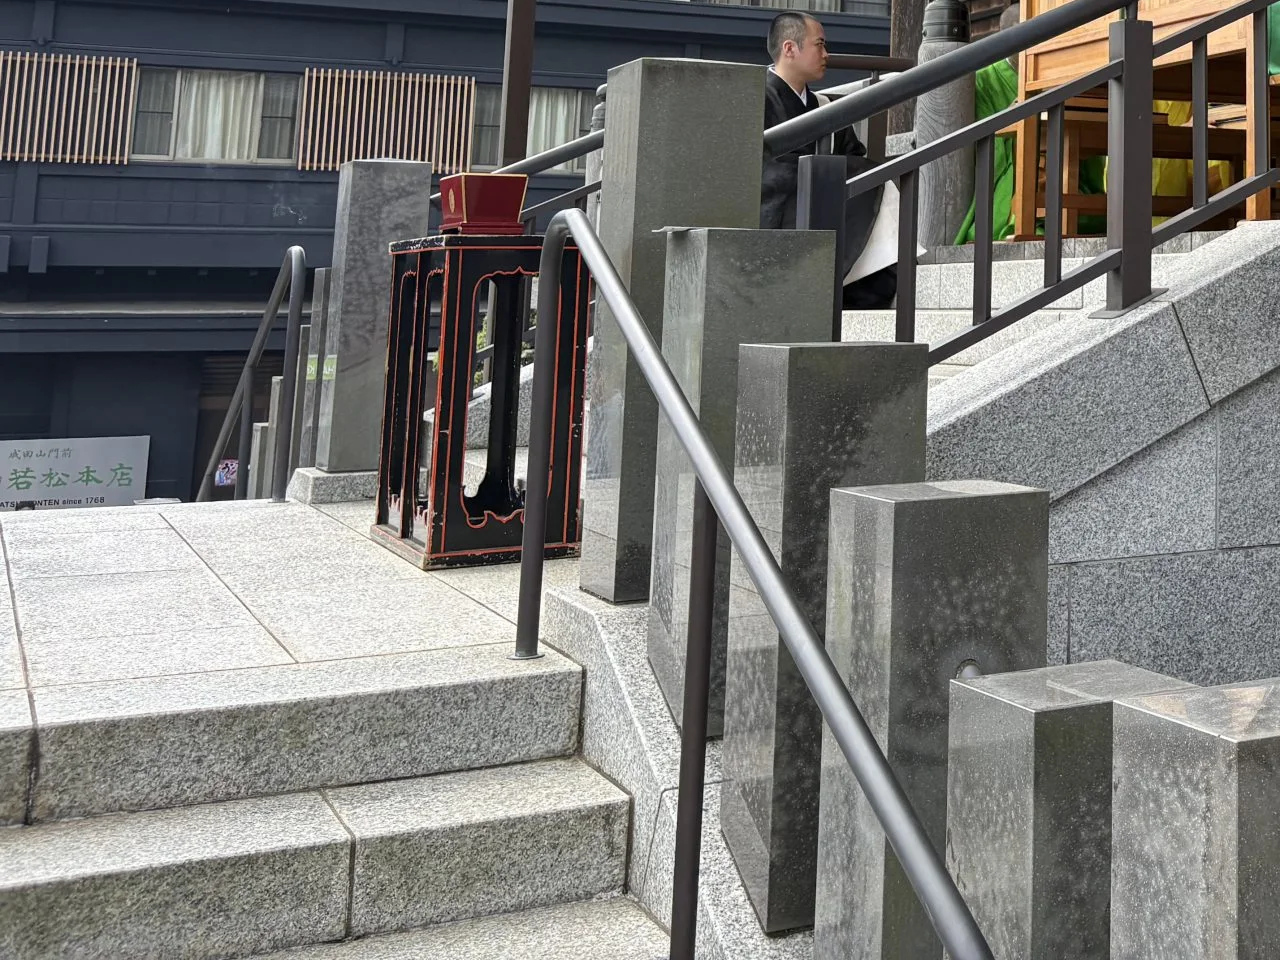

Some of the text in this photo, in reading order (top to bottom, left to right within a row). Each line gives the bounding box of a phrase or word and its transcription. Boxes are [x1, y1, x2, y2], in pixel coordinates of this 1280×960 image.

[8, 447, 73, 459] 成田山門前
[7, 463, 133, 490] 若松本店
[86, 496, 105, 504] 1768
